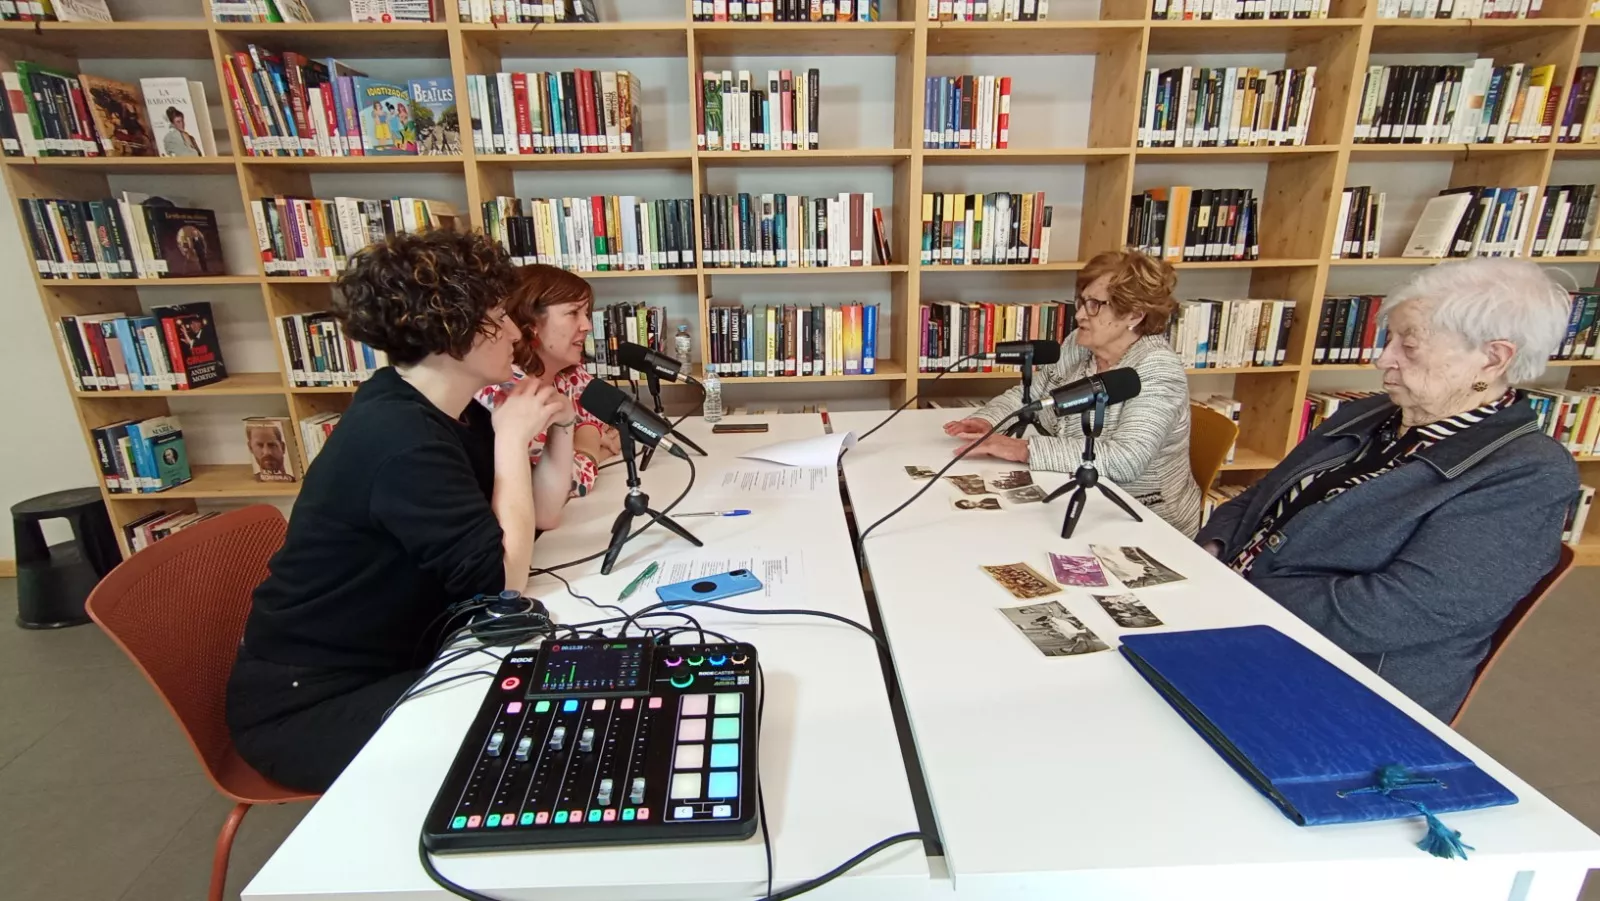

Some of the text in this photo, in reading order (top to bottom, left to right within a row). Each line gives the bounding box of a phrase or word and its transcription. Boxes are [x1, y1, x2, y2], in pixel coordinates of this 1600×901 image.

[412, 83, 454, 102] BEATLES
[190, 365, 216, 376] ANDREW
[192, 372, 217, 383] MORTON
[632, 421, 658, 439] SHURE
